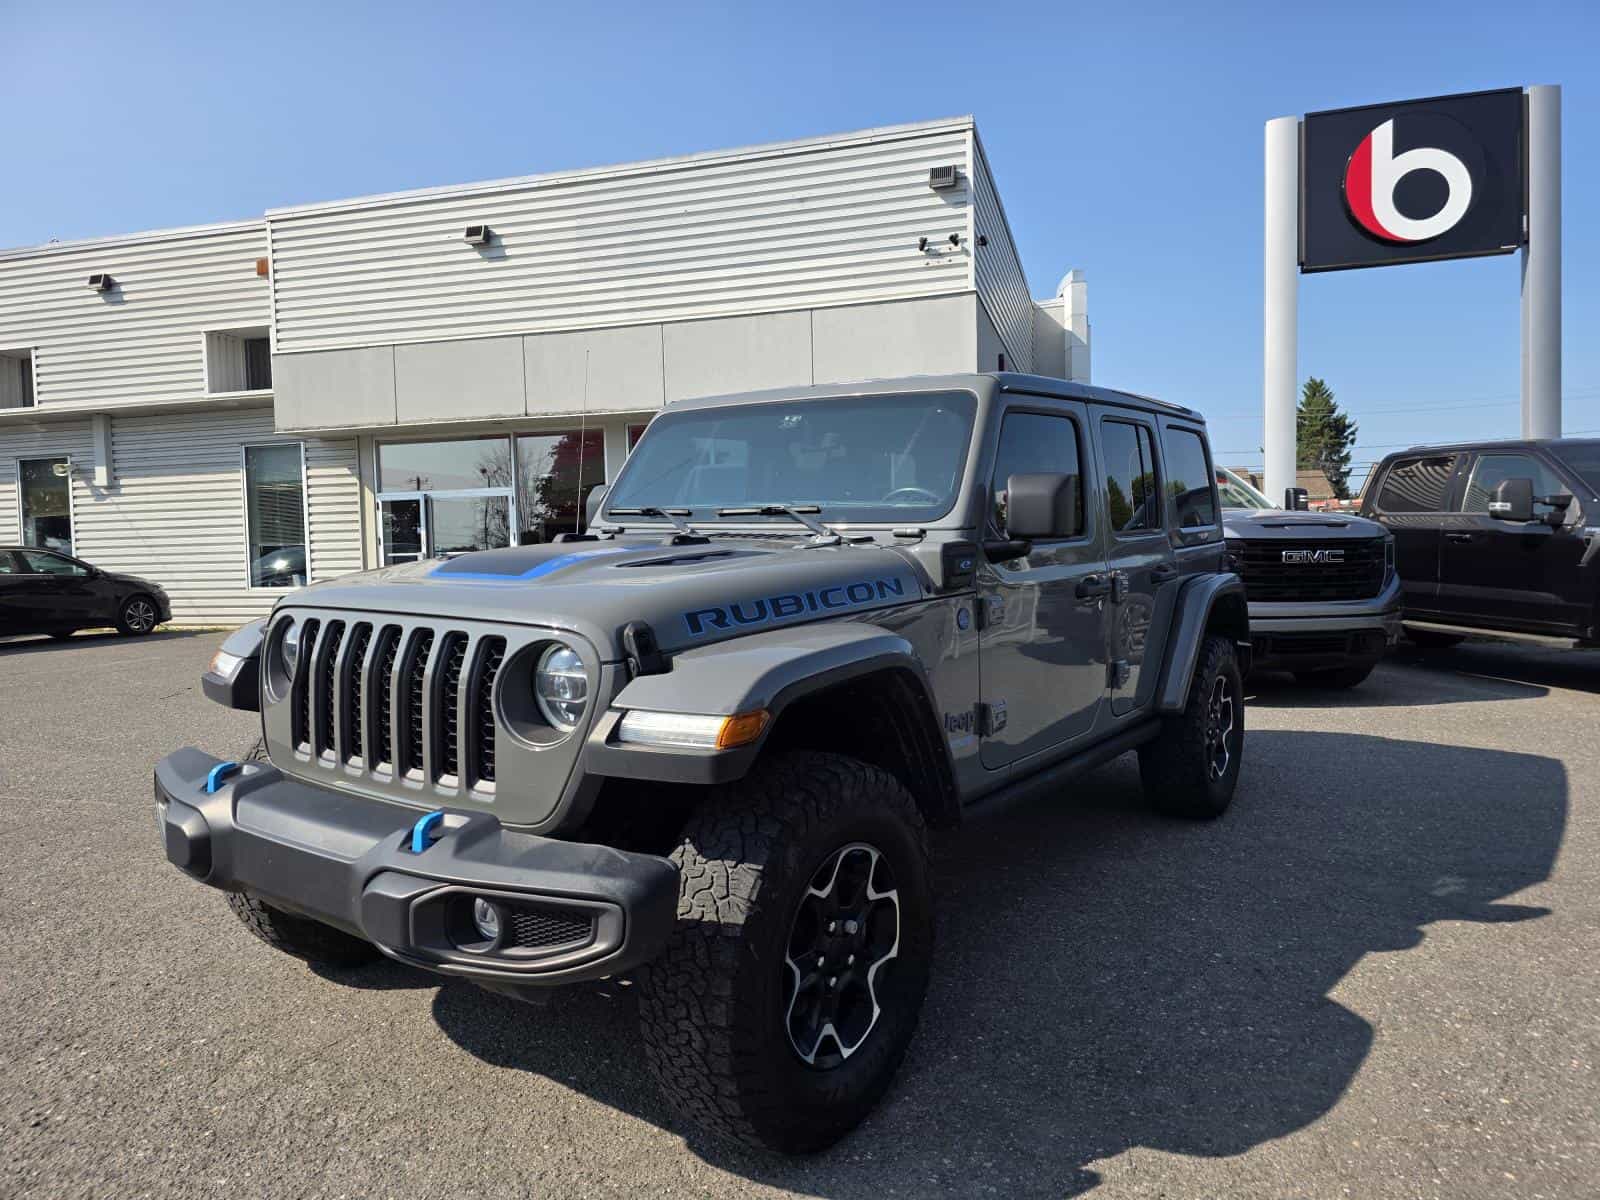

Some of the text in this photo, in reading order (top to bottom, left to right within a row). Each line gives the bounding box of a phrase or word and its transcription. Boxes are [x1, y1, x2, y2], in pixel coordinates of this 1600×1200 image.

[1348, 118, 1473, 241] b
[1281, 549, 1345, 564] GMC
[684, 577, 905, 635] RUBICON
